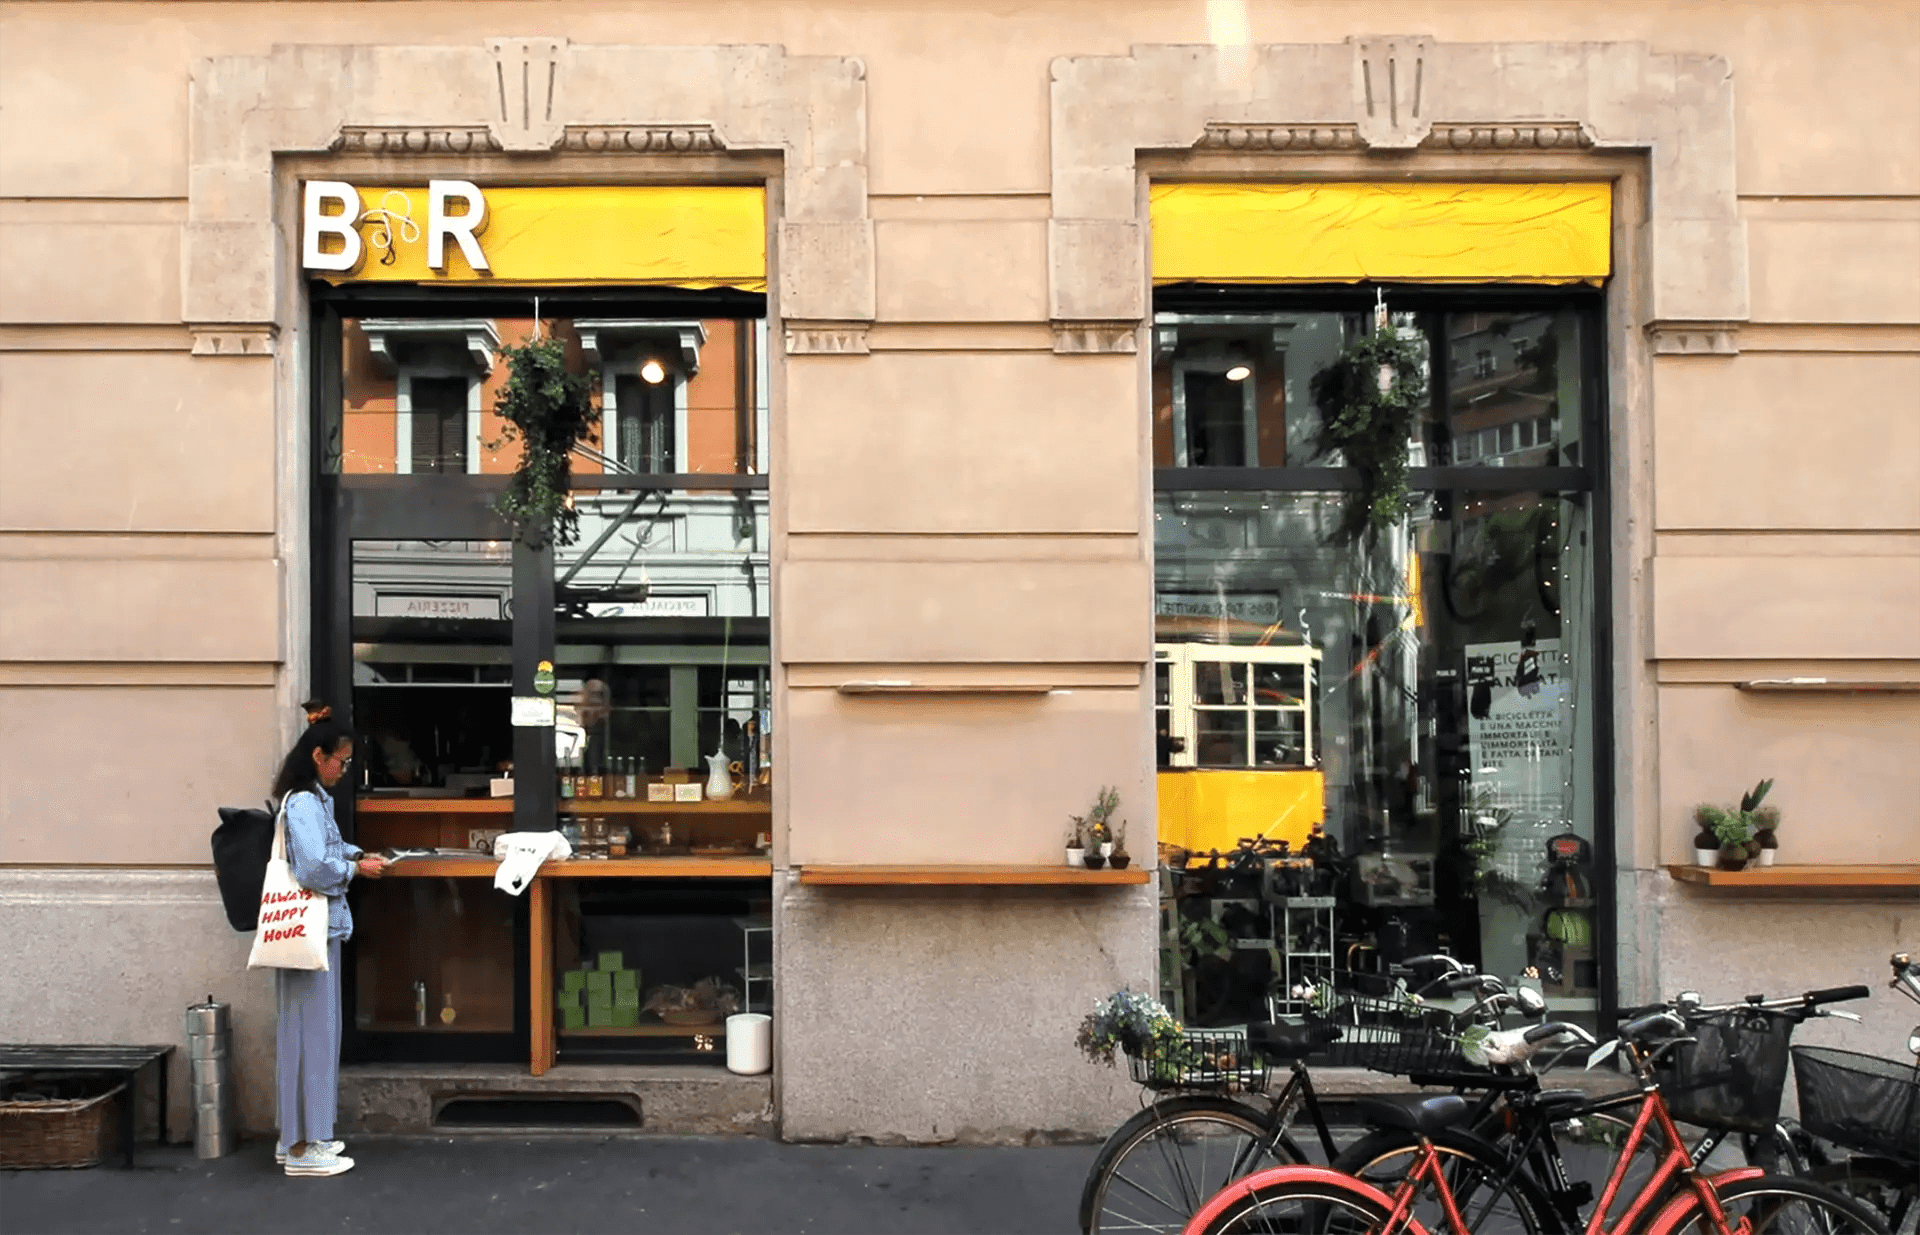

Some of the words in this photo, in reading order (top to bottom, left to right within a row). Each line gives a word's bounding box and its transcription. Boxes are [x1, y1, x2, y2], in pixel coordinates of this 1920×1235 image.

[261, 889, 313, 904] ALWAYS
[262, 905, 308, 924] HAPPY
[263, 924, 306, 943] HOUR
